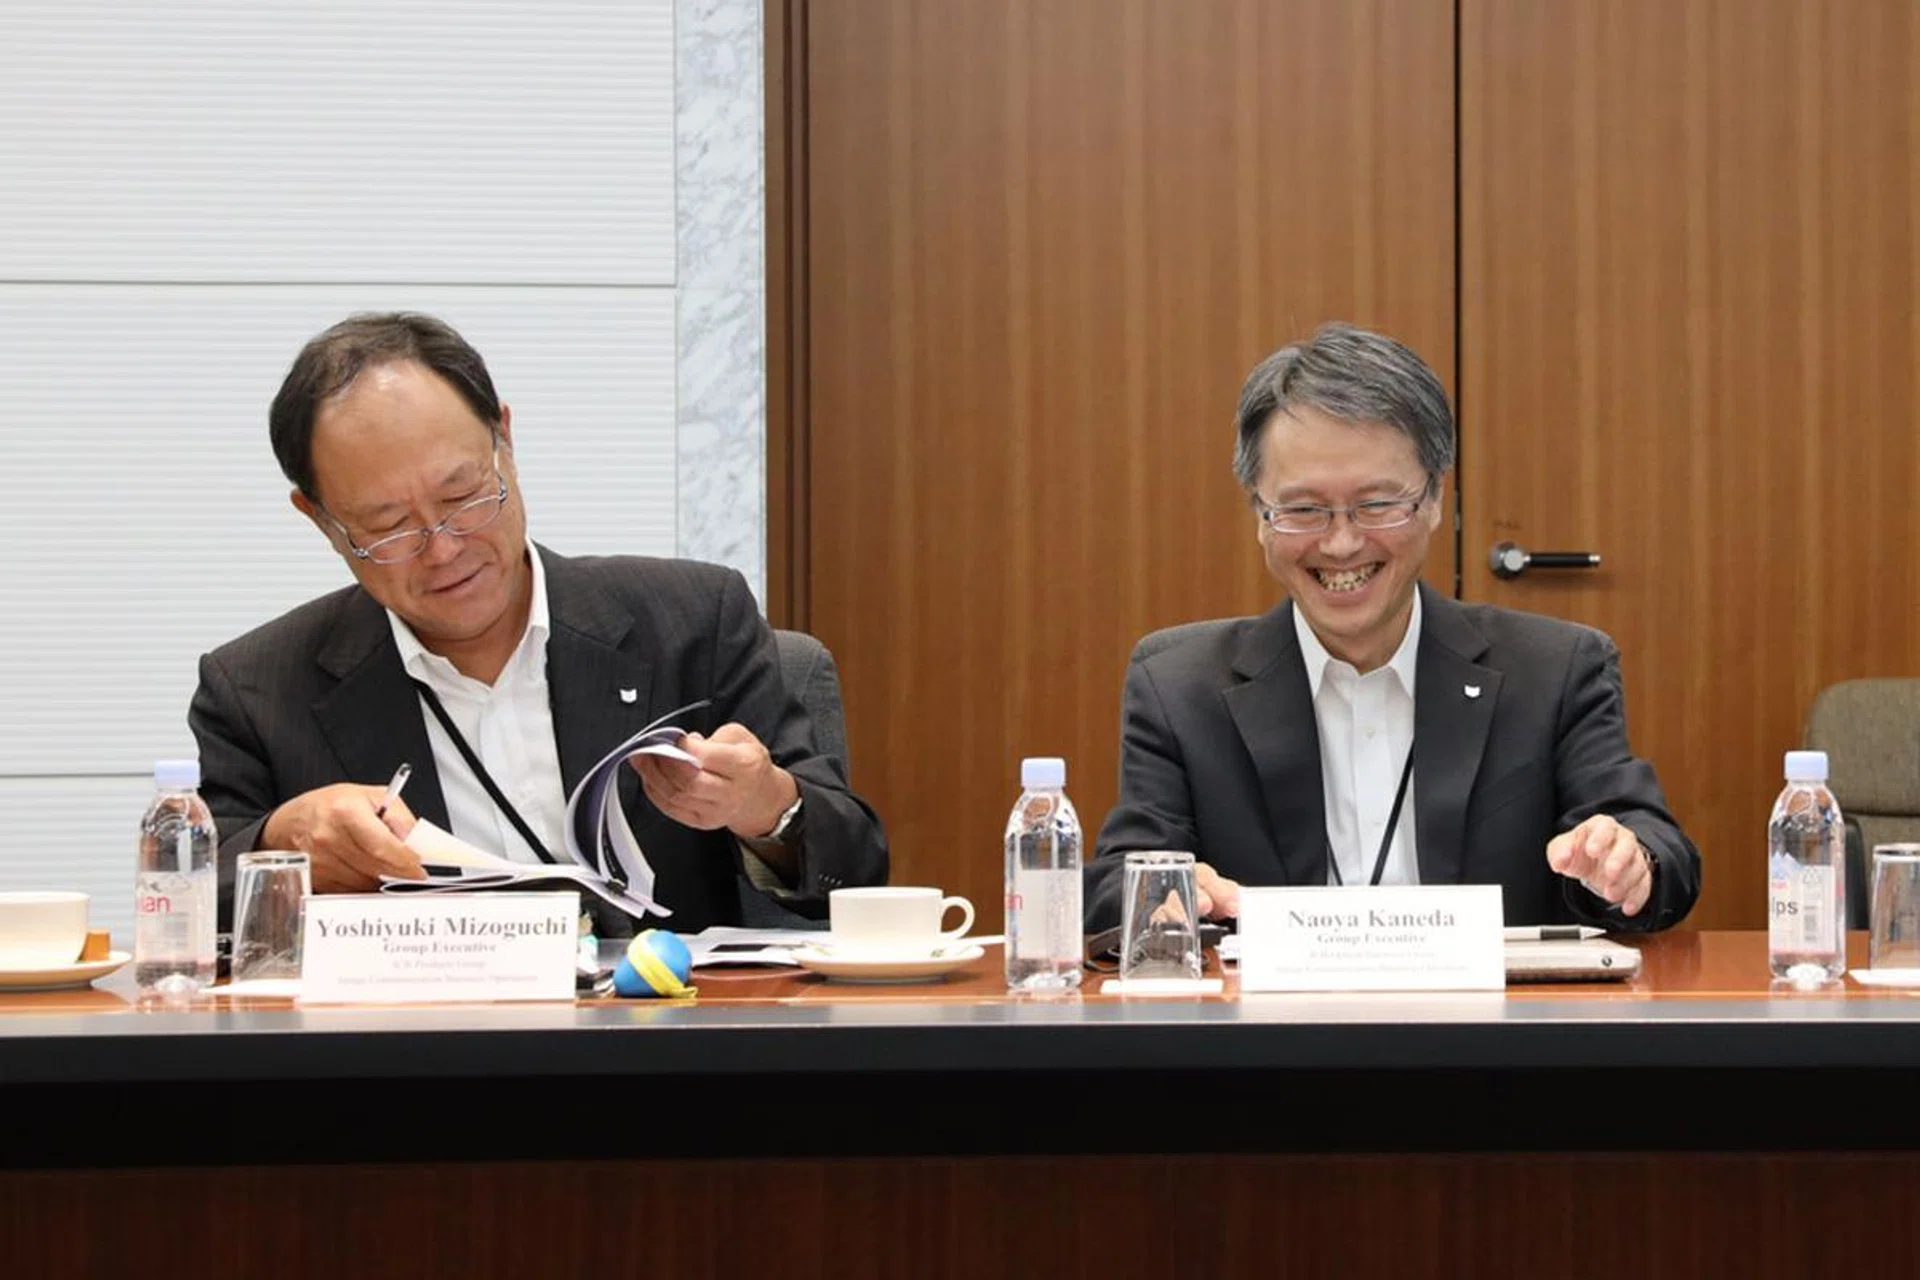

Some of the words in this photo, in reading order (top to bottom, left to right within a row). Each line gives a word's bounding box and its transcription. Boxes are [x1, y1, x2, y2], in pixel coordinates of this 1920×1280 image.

[317, 917, 435, 941] Yoshiyuki
[445, 916, 567, 939] Mizoguchi
[1288, 909, 1360, 933] Naoya
[1368, 908, 1455, 928] Kaneda
[383, 942, 429, 954] Group
[432, 942, 497, 953] Executive
